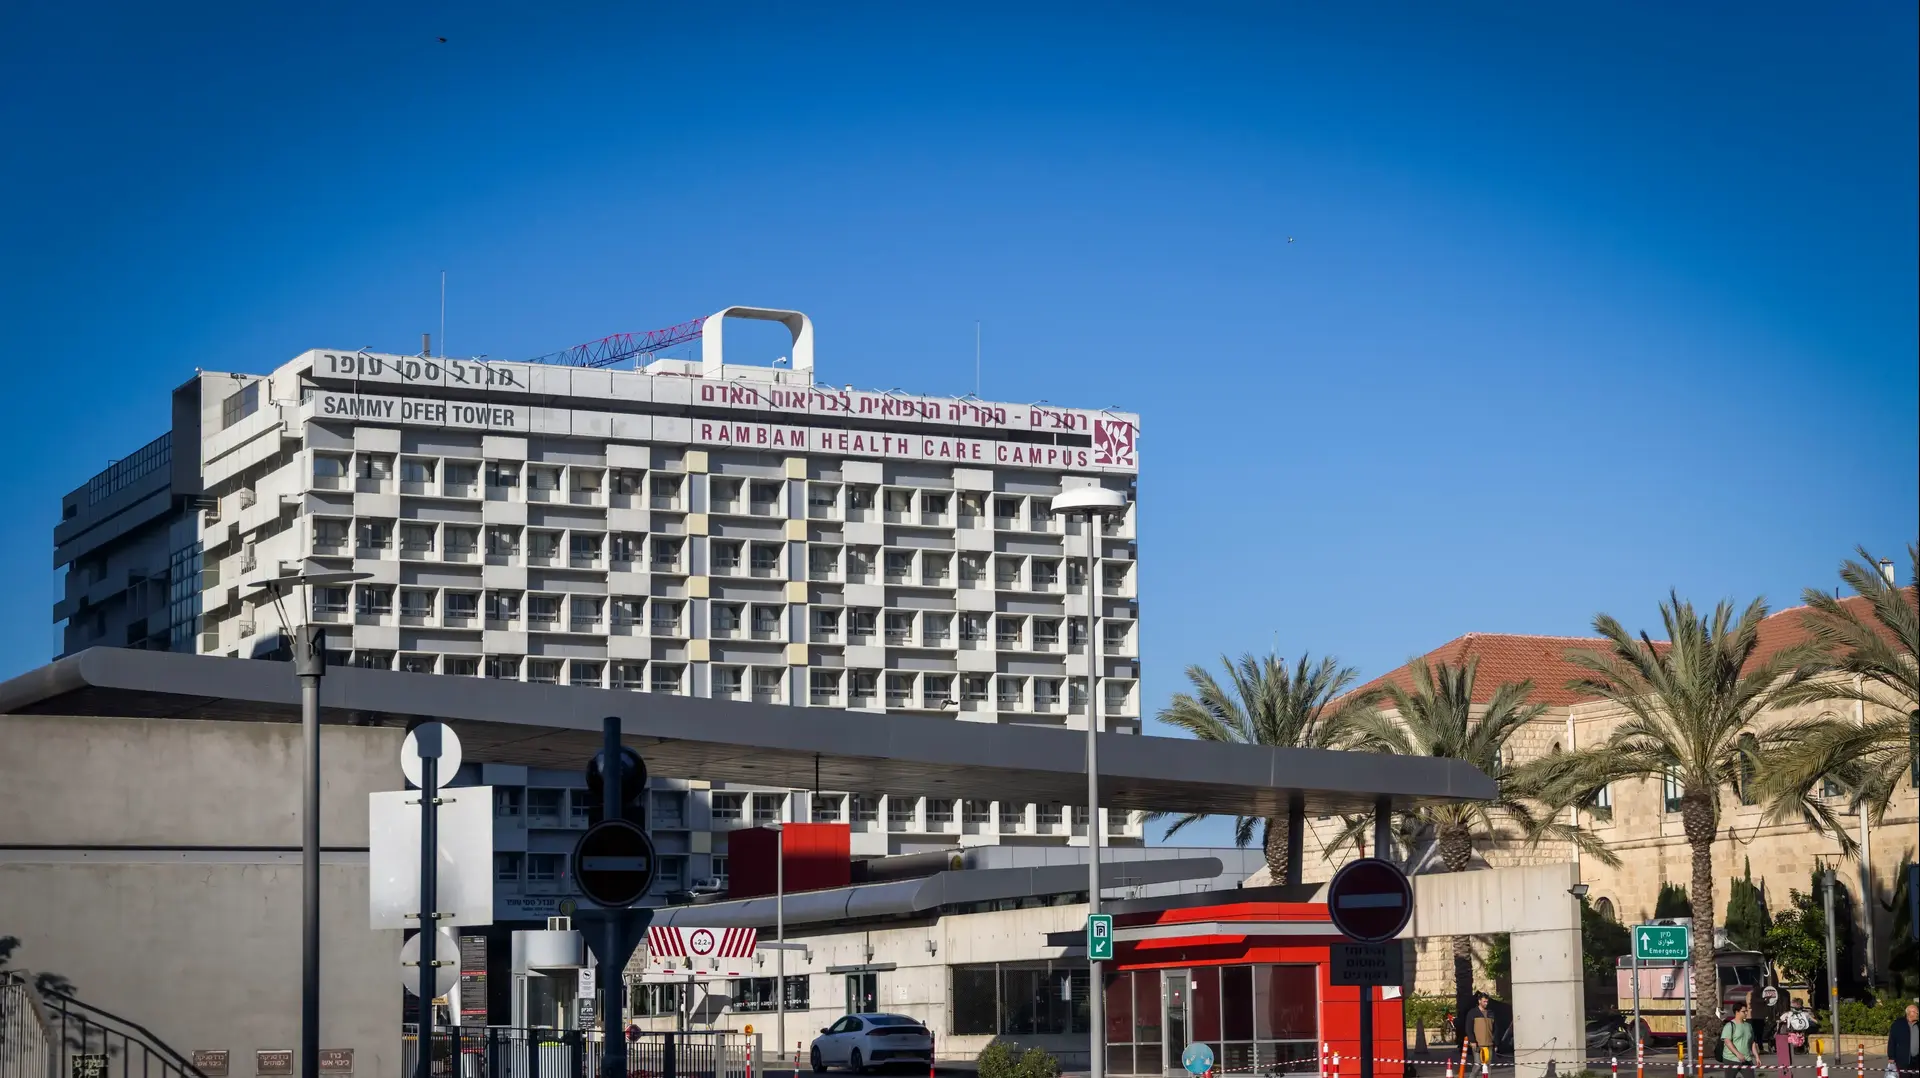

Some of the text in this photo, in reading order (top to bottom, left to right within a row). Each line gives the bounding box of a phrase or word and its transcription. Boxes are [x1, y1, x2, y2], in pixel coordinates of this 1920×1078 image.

[324, 354, 514, 386] מגדל סמי עופר
[701, 384, 759, 405] האדם
[770, 390, 852, 412] לבריאות
[324, 396, 515, 427] SAMMY OFER TOWER
[859, 396, 941, 419] הרפואית
[949, 404, 1006, 427] הקריה
[701, 423, 1088, 468] RAMBAM HEALTH CARE CAMPUS
[1660, 931, 1671, 939] מיון
